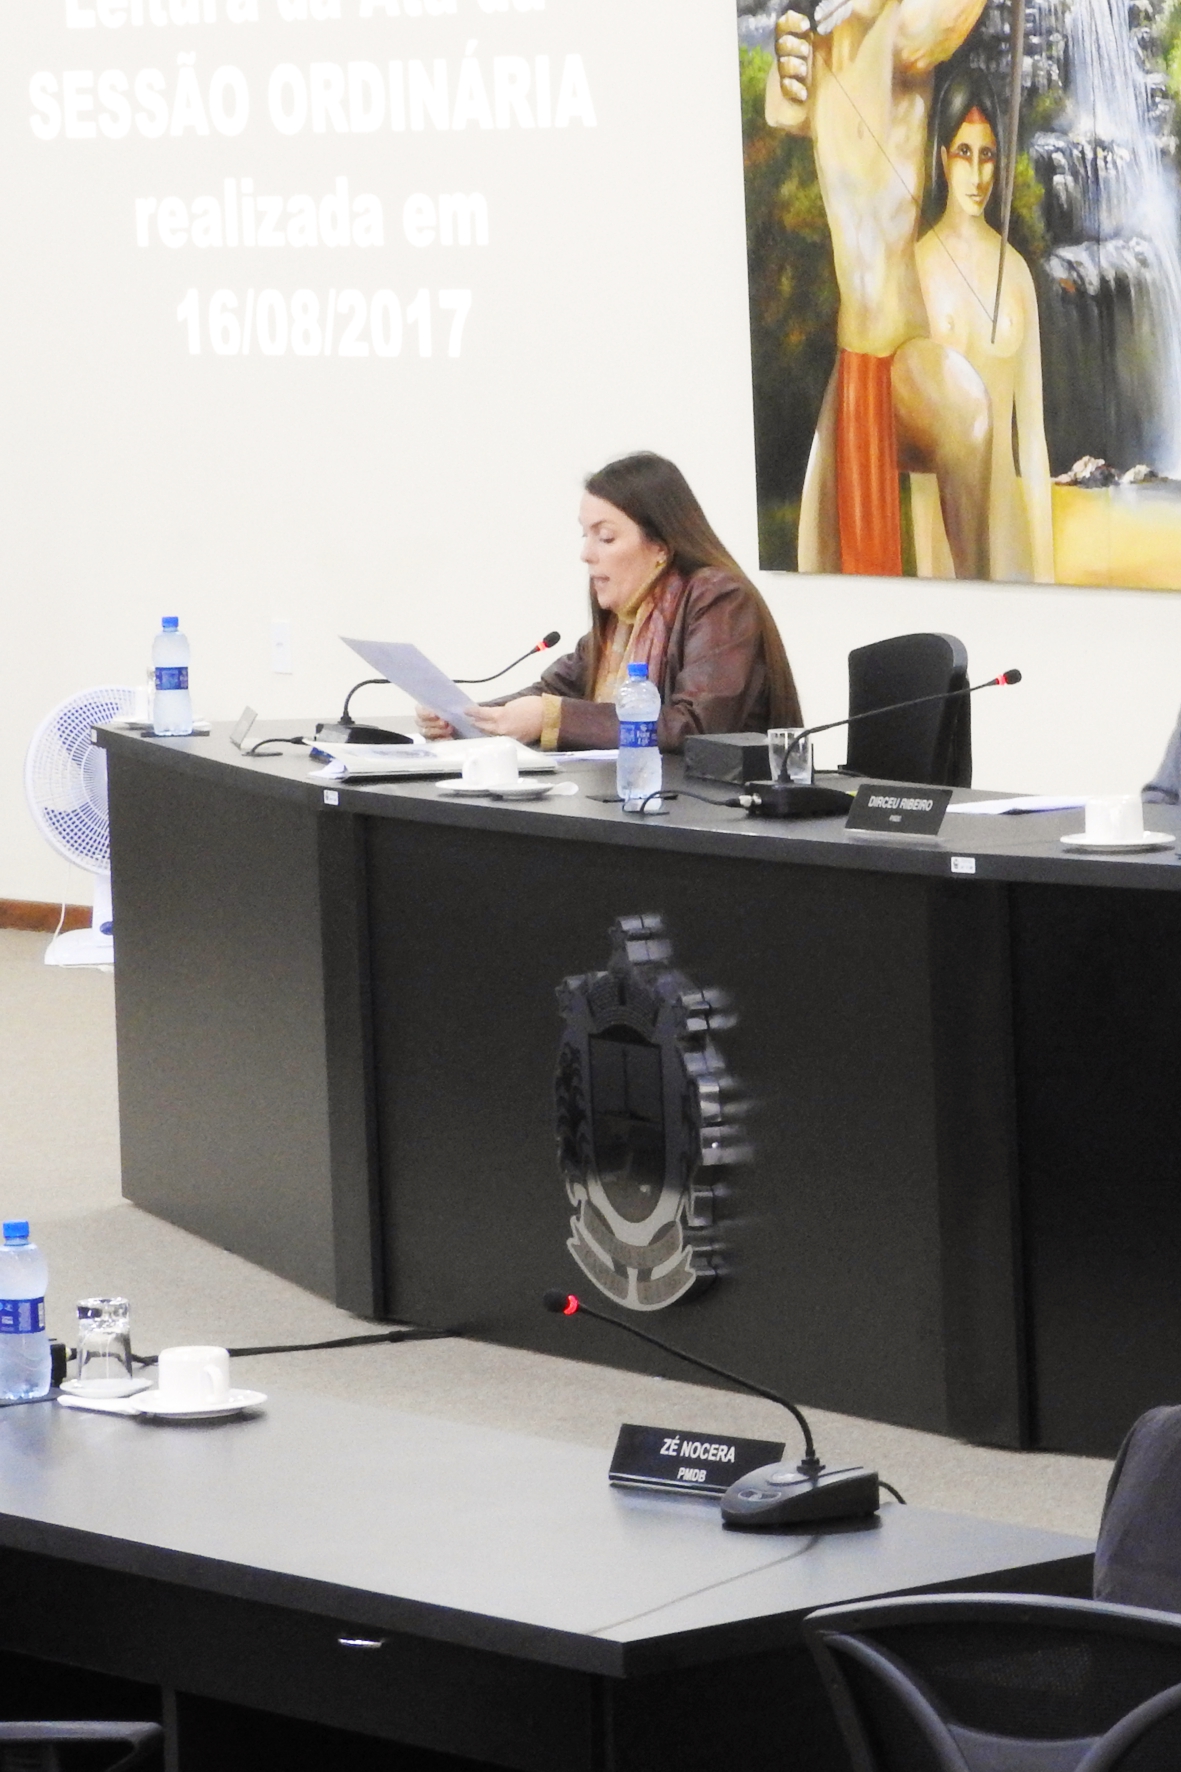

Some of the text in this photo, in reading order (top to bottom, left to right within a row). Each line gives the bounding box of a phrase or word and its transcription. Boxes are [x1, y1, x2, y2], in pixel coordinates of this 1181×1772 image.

[28, 38, 598, 141] SESSÃO ORDINÁRIA
[134, 175, 490, 249] realizada em
[176, 287, 474, 359] 16/08/2017
[867, 795, 934, 811] DIRCEU RIBEIRO
[660, 1435, 736, 1463] ZÉ NOCERA
[677, 1467, 707, 1482] PMDB
